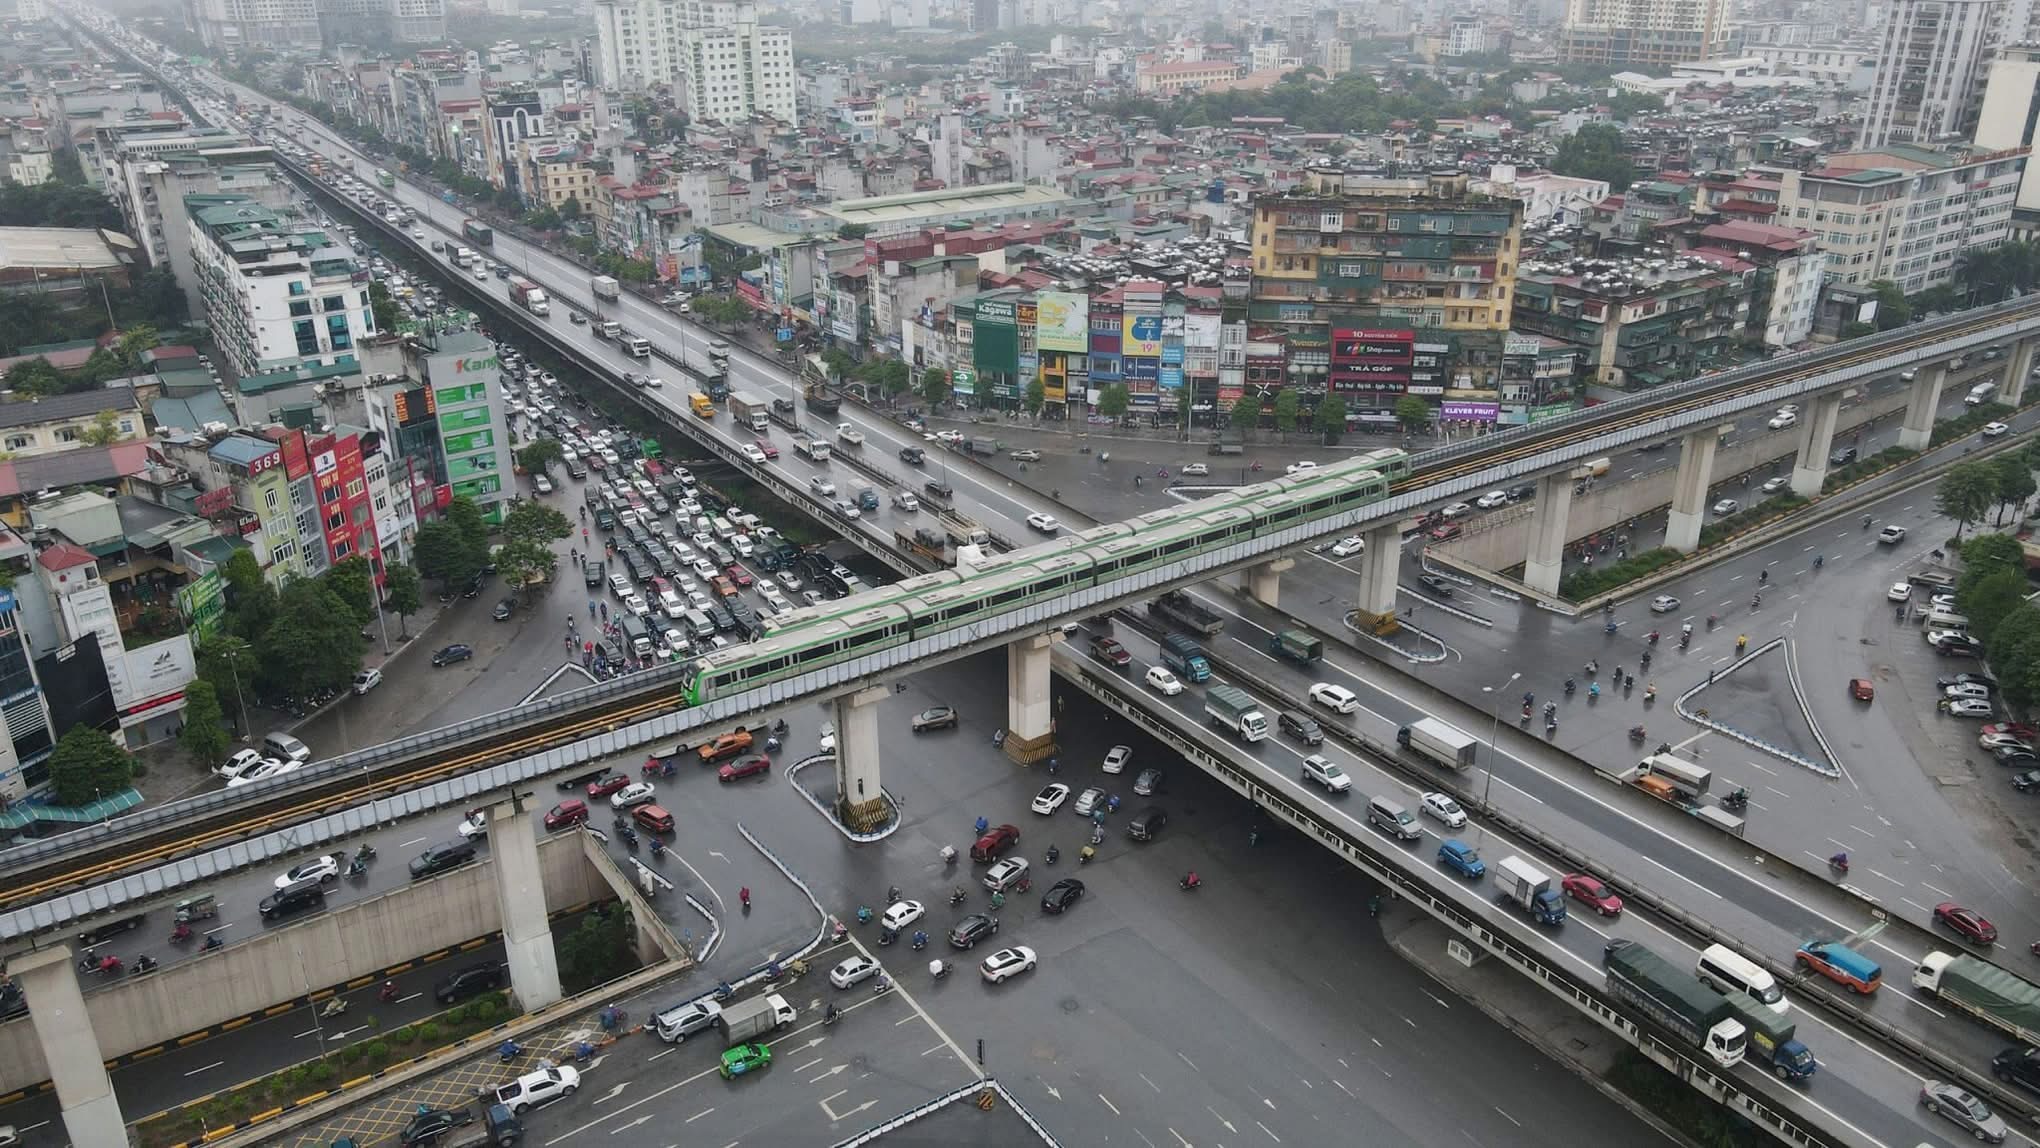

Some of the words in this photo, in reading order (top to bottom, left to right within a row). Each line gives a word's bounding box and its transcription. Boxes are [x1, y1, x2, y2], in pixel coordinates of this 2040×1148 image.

[979, 304, 1012, 316] Kagawa
[1352, 330, 1364, 338] 10
[1345, 342, 1366, 356] FPT
[1445, 407, 1473, 415] KLEVER
[1474, 408, 1495, 416] FRUIT
[254, 452, 280, 473] 369
